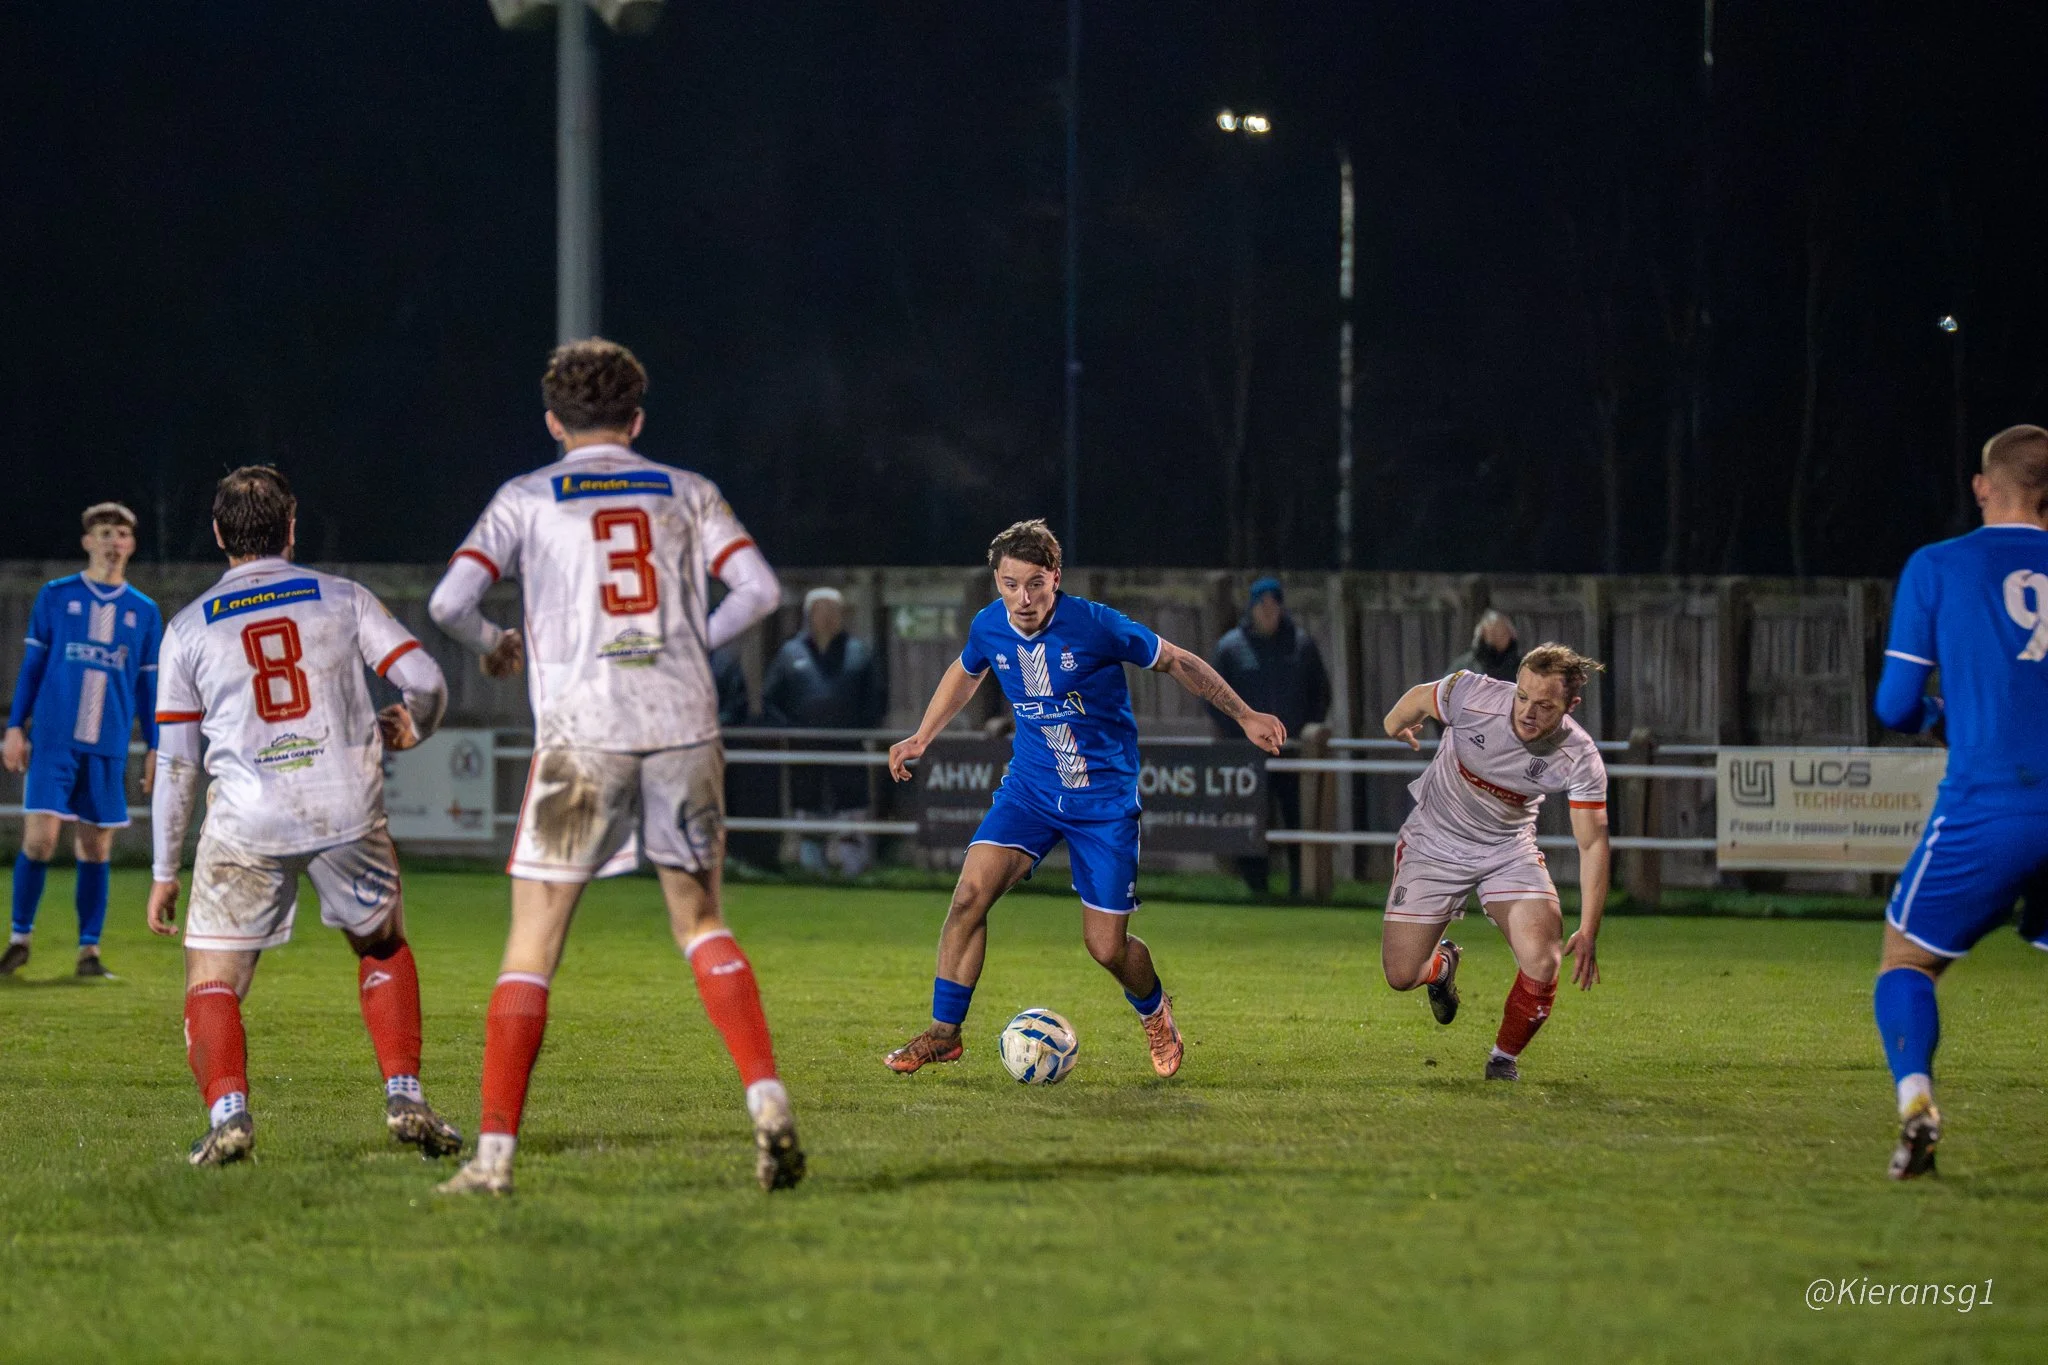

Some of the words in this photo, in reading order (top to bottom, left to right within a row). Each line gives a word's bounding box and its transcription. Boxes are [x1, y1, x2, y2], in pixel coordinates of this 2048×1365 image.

[592, 506, 658, 617] 3
[2003, 569, 2048, 662] 9
[240, 616, 311, 723] 8
[926, 762, 993, 789] AHW
[1138, 765, 1197, 795] ONS
[1205, 765, 1257, 795] LTD
[1790, 760, 1871, 786] UCS
[1794, 791, 1921, 810] TECHNOLOGIES
[1729, 817, 1773, 832] Proud
[1775, 819, 1791, 832] to
